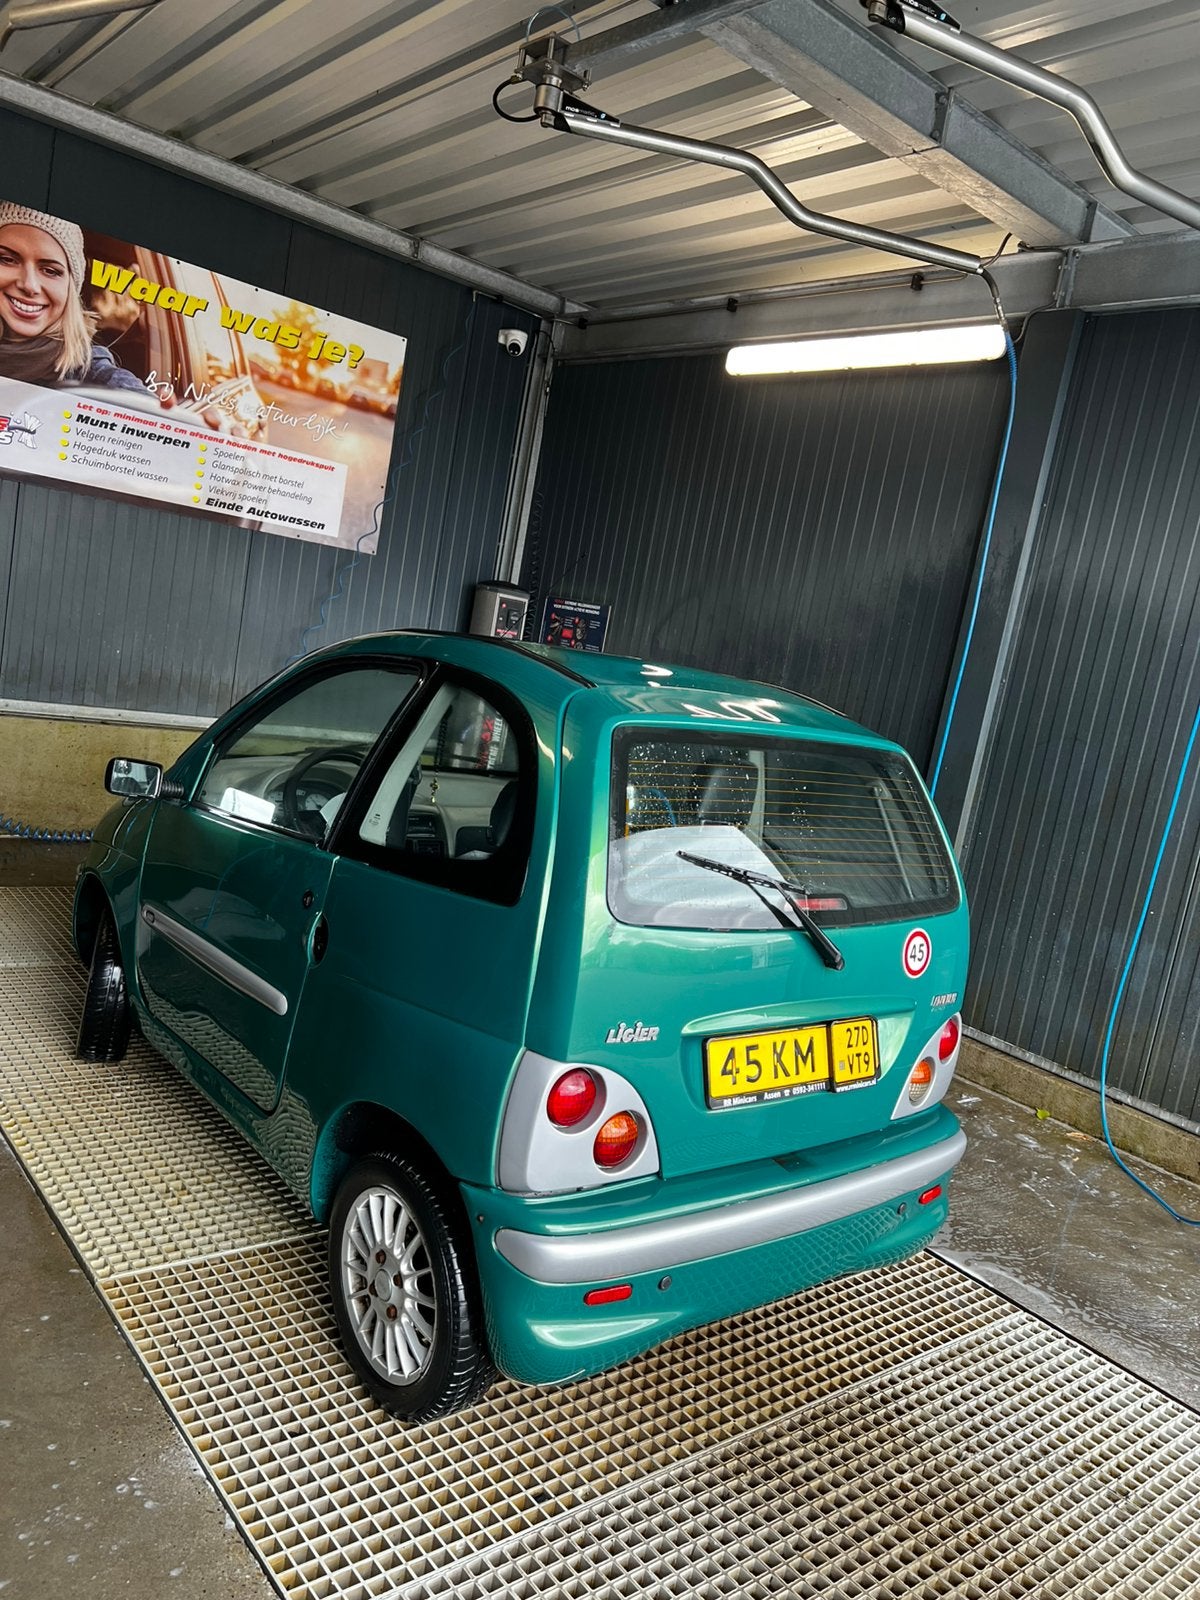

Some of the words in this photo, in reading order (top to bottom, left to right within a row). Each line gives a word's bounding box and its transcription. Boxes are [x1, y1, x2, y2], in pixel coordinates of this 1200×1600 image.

[90, 258, 209, 318] Waar
[220, 306, 302, 349] was
[307, 331, 365, 369] je?
[144, 370, 178, 402] Bij
[244, 400, 351, 442] atuurlijk!
[75, 426, 106, 443] Velgen
[107, 435, 143, 452] reinigen
[76, 413, 118, 432] Munt
[120, 424, 191, 450] inwerpen
[76, 402, 94, 412] Let
[96, 407, 112, 417] op:
[114, 411, 159, 428] minimaal
[160, 423, 172, 431] 20
[174, 427, 187, 435] cm
[188, 430, 225, 445] afstand
[226, 439, 258, 453] houden
[259, 448, 277, 458] met
[277, 452, 336, 473] hogedrukspuit
[73, 441, 118, 459] Hogedruk
[119, 451, 152, 466] wassen
[213, 447, 246, 463] Spoelen
[71, 454, 136, 476] Schuimborstel
[136, 469, 169, 484] wassen
[211, 460, 261, 478] Glanspolisch
[262, 473, 278, 484] met
[278, 475, 305, 489] borstel
[208, 485, 237, 501] Vlekvrij
[237, 493, 268, 507] spoelen
[209, 473, 241, 487] Hotwax
[242, 480, 267, 493] Power
[267, 486, 313, 505] behandeling
[205, 497, 244, 513] Einde
[246, 506, 326, 531] Autowassen
[909, 943, 925, 963] 45
[846, 1025, 870, 1049] 27D
[720, 1044, 762, 1086] 45
[772, 1036, 816, 1080] KM
[847, 1051, 871, 1076] VT9
[763, 1090, 781, 1101] Assen
